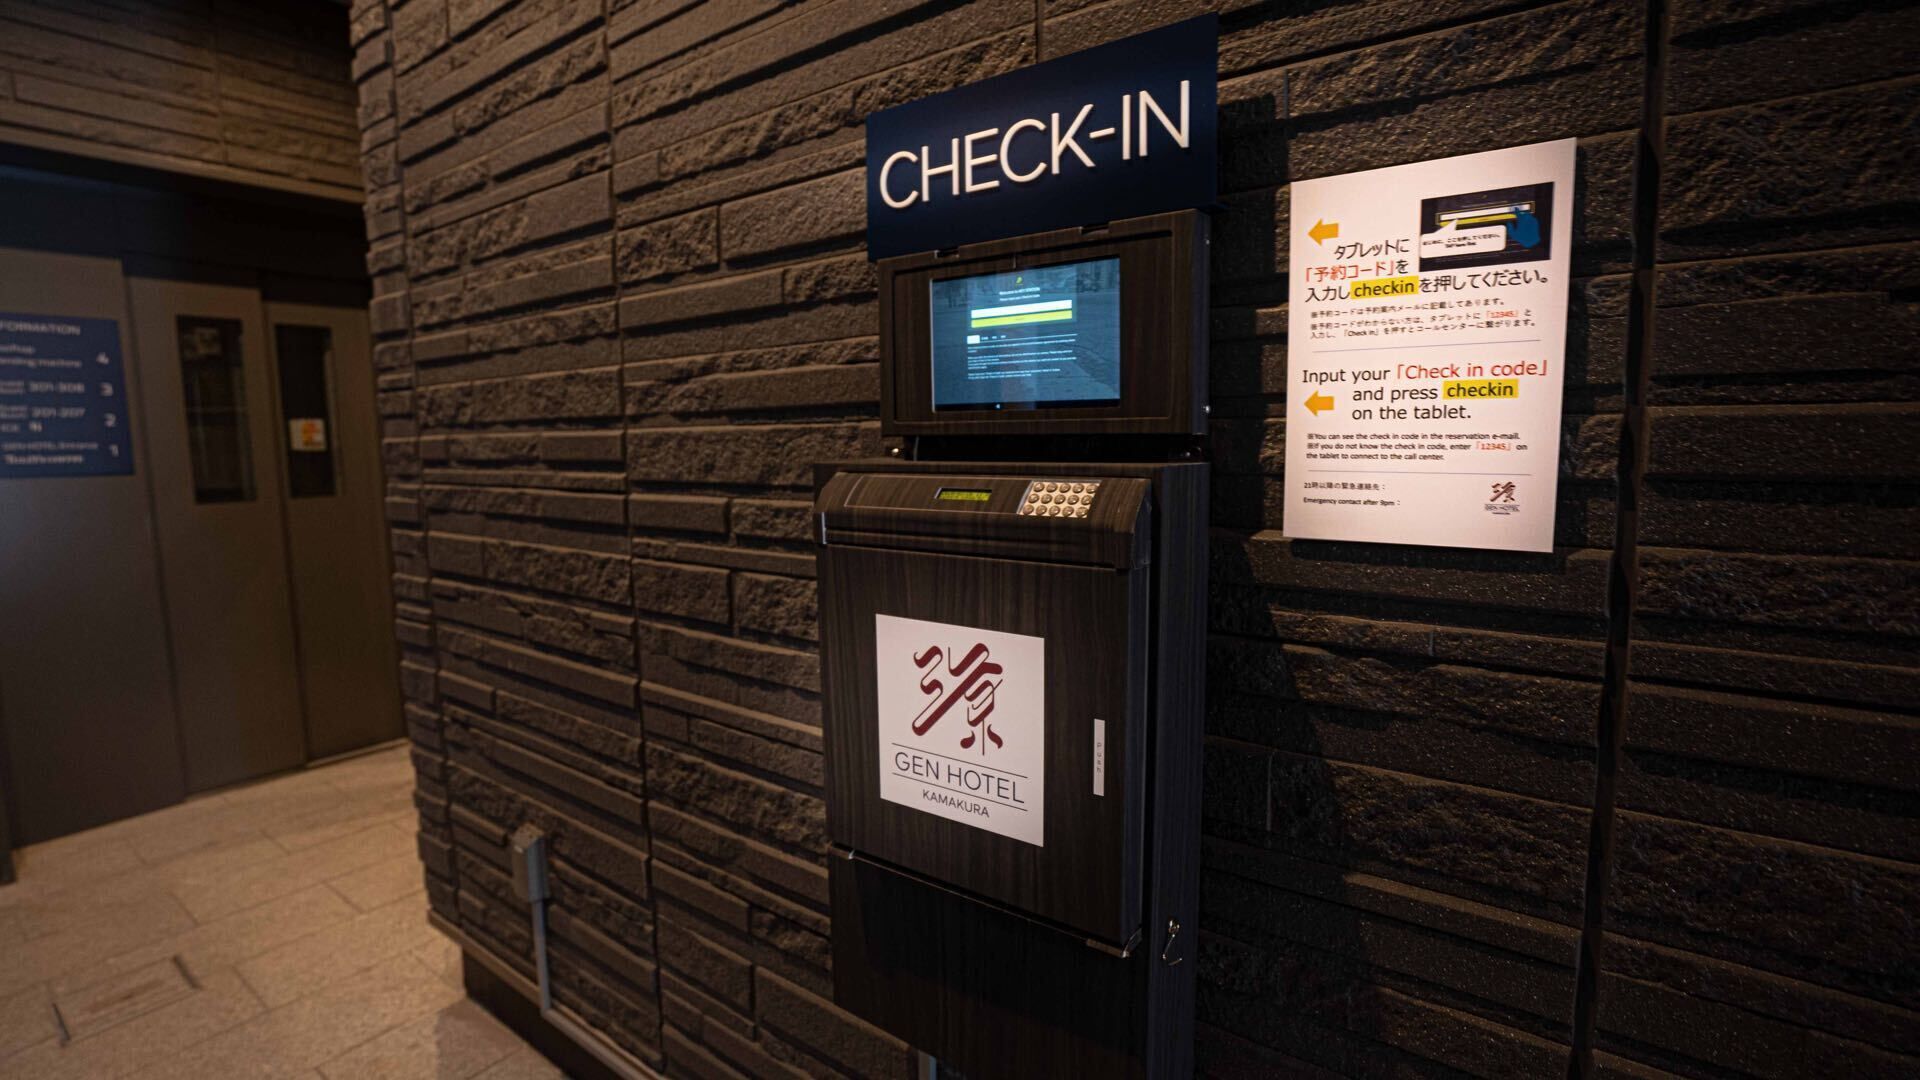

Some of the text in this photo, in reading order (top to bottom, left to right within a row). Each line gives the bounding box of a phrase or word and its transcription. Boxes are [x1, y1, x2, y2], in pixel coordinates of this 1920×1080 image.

[879, 79, 1190, 209] CHECK-IN
[1334, 239, 1410, 260] タブレットに
[1302, 369, 1346, 385] Input
[1352, 369, 1391, 384] your
[1467, 362, 1483, 377] in
[1352, 382, 1513, 403] and press checkin
[1352, 405, 1471, 420] on the tablet.
[1303, 497, 1337, 505] Emergency
[895, 751, 1025, 804] GEN HOTEL
[922, 789, 990, 818] KAMAKURA
